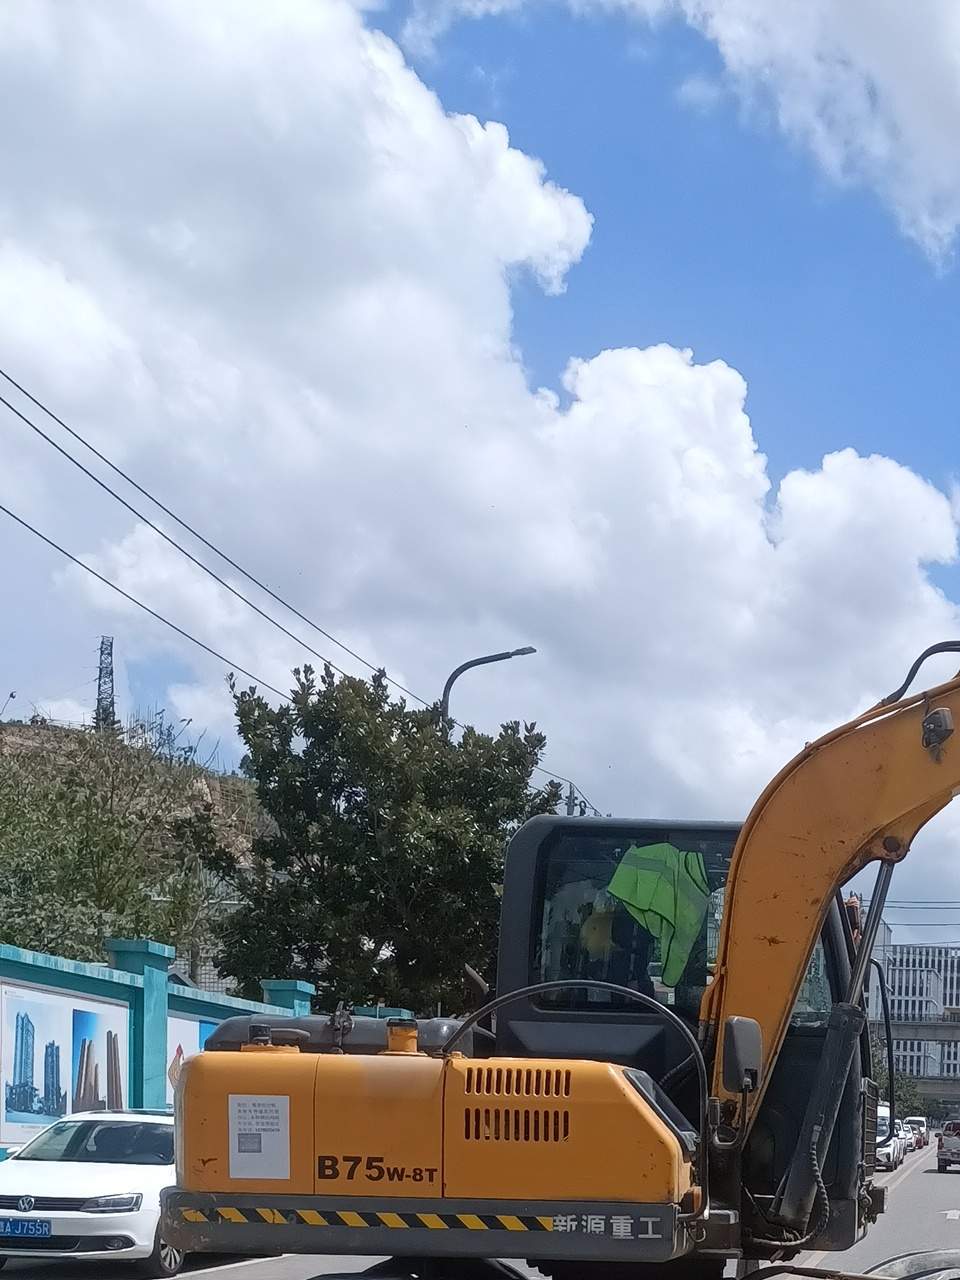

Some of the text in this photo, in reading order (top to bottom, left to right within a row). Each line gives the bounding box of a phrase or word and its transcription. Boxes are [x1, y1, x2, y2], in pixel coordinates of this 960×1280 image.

[317, 1155, 438, 1183] B75W-8T
[553, 1213, 663, 1240] 新源重工
